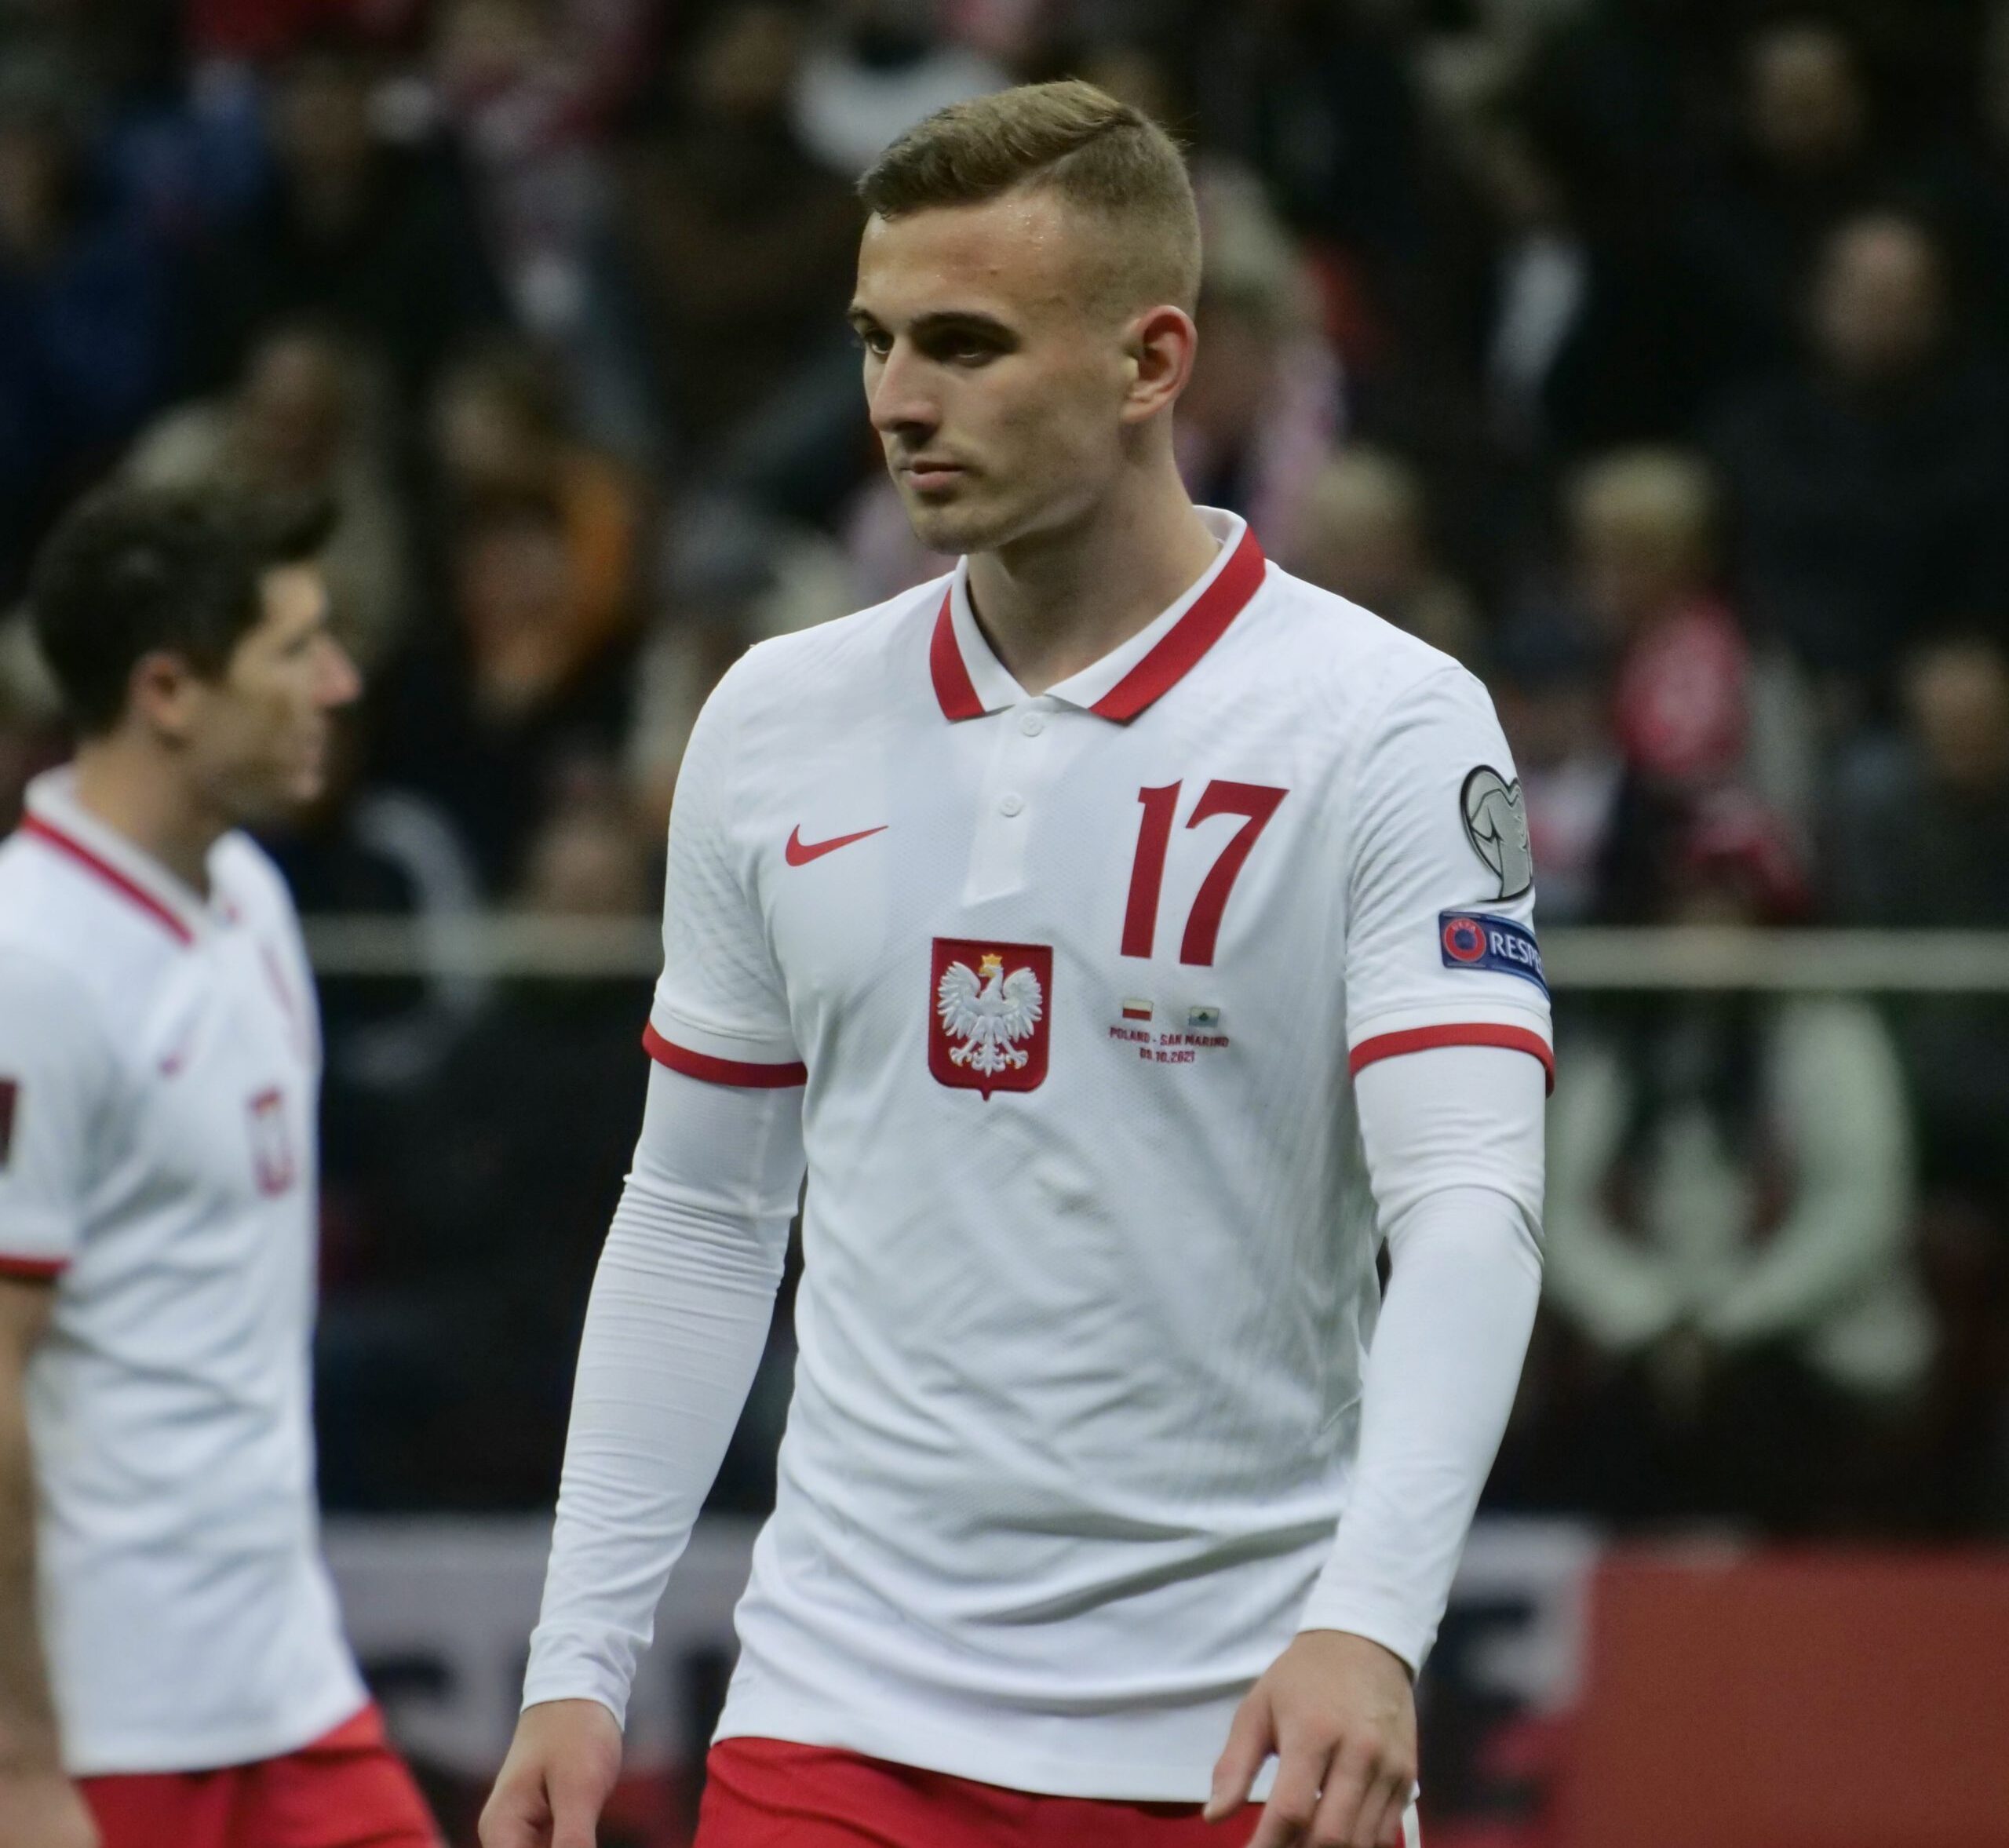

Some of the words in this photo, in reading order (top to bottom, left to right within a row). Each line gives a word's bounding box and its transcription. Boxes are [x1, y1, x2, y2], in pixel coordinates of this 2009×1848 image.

[1120, 778, 1290, 968] 17
[1110, 1027, 1150, 1043] POLAND
[1160, 1033, 1181, 1046] SAN
[1185, 1034, 1230, 1048] MARINO
